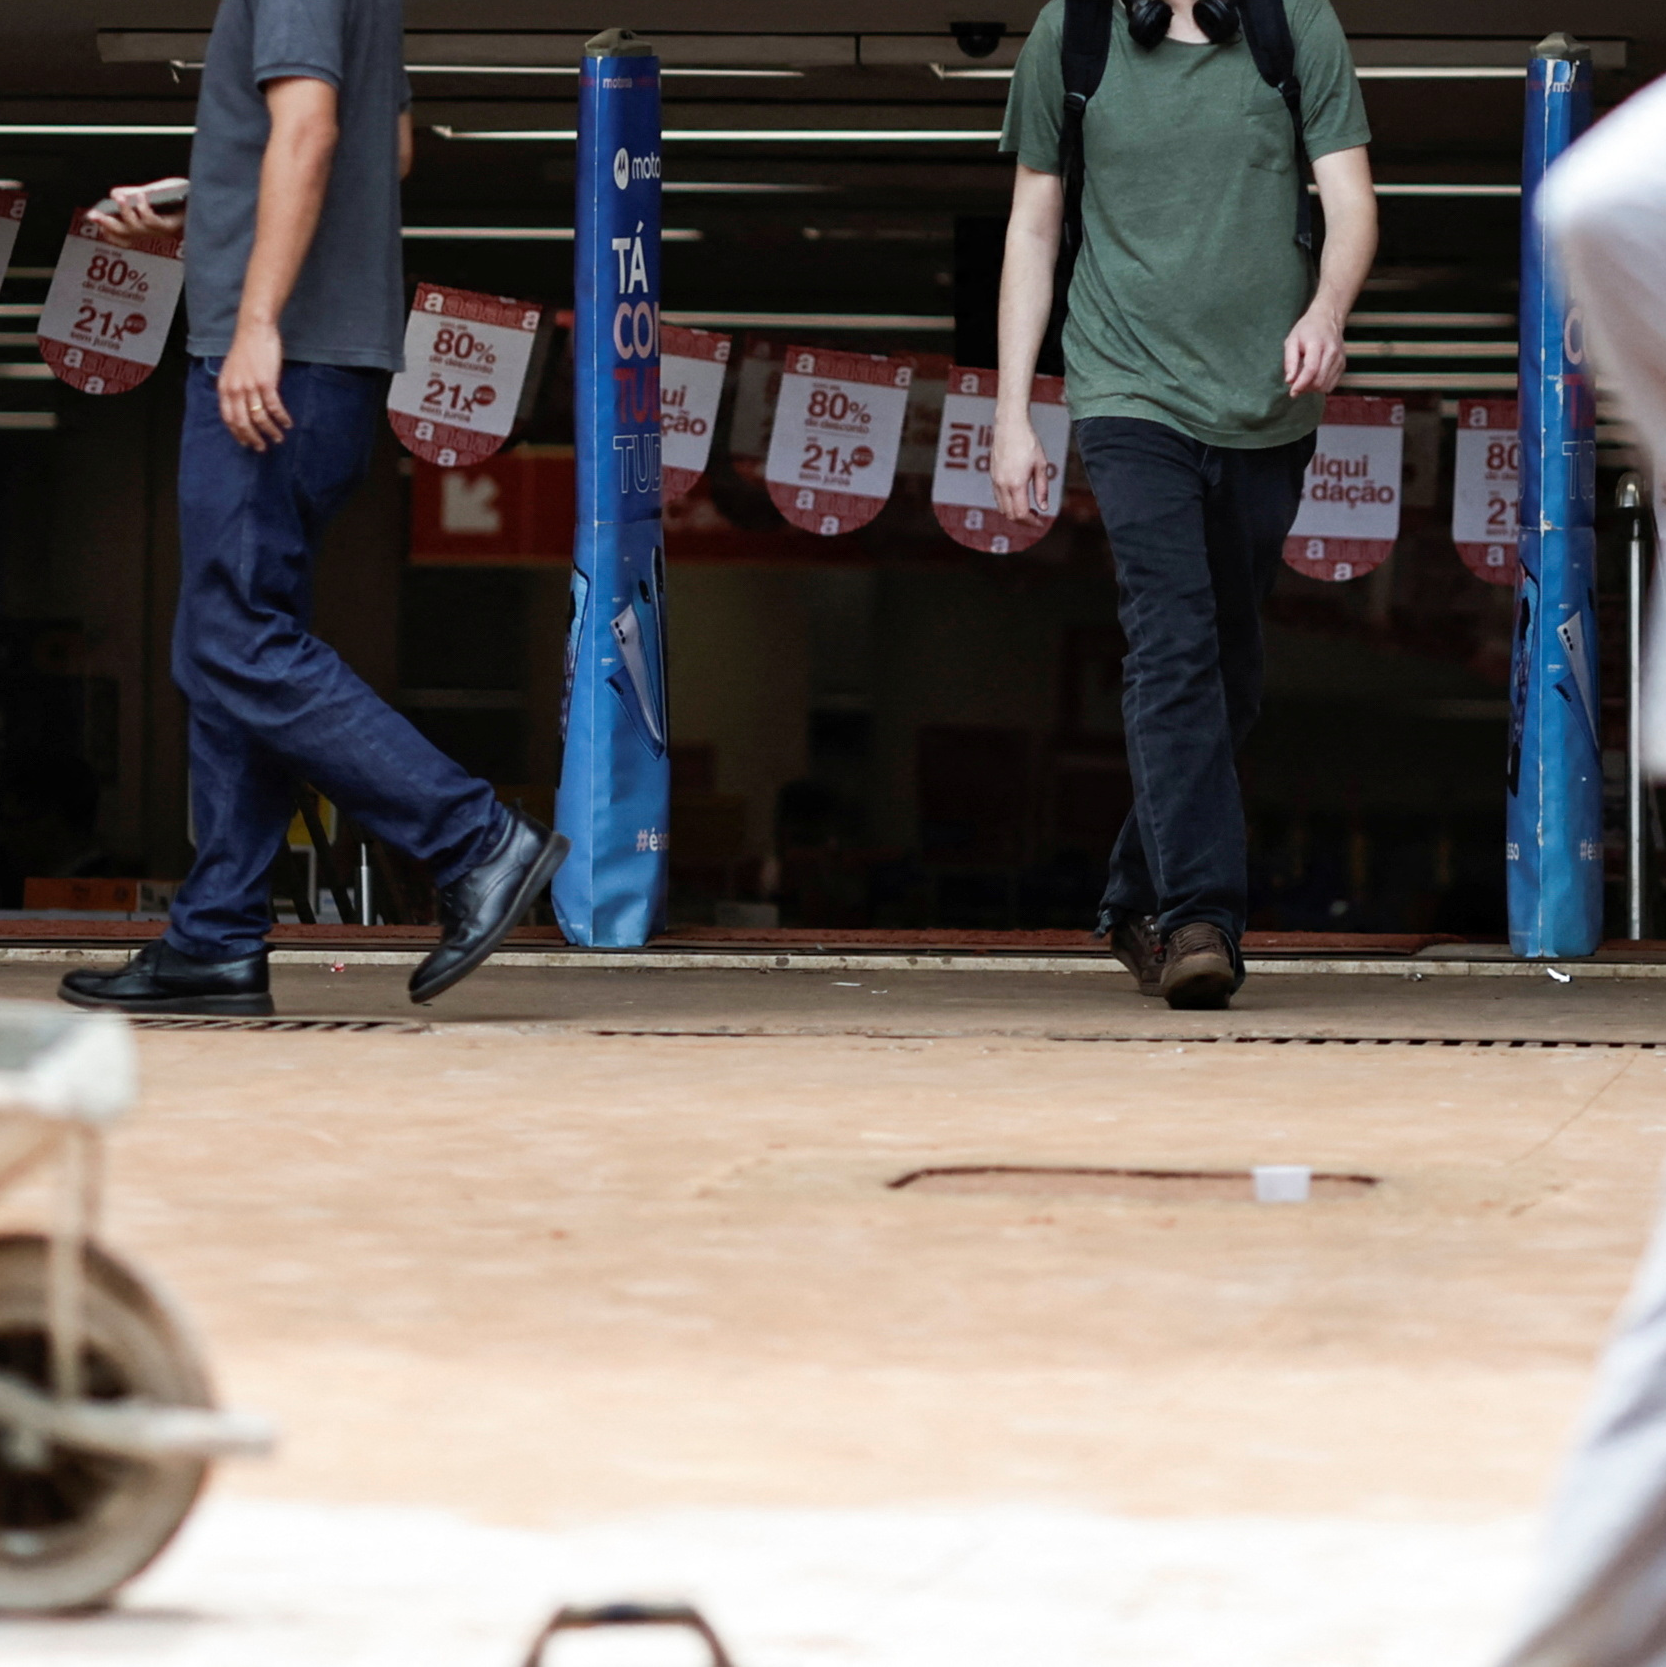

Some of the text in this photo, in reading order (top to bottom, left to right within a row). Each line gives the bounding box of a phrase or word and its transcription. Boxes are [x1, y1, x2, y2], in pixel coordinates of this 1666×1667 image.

[632, 151, 662, 180] moto
[86, 254, 150, 293] 80%
[611, 220, 649, 295] TÁ
[73, 305, 125, 342] 21x
[433, 328, 497, 365] 80%
[422, 378, 475, 414] 21x
[807, 389, 873, 425] 80%
[800, 443, 853, 476] 21x
[1310, 453, 1369, 482] liqui
[1311, 479, 1395, 509] dação
